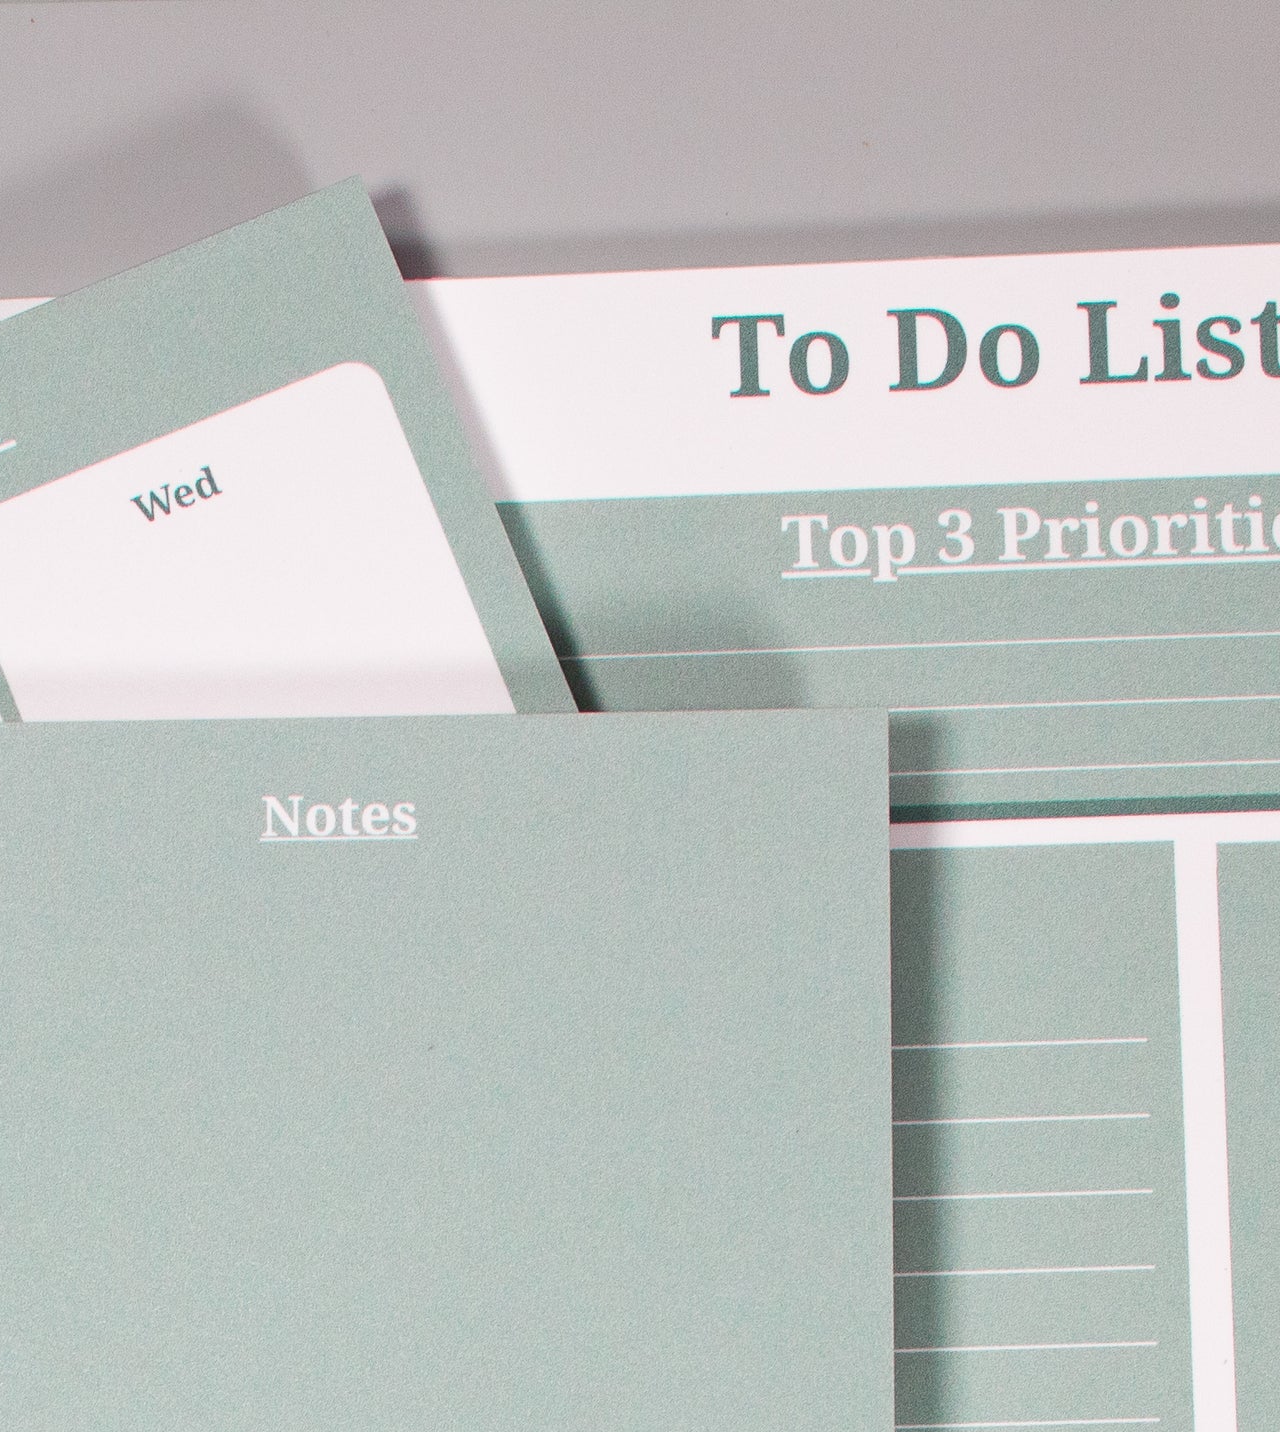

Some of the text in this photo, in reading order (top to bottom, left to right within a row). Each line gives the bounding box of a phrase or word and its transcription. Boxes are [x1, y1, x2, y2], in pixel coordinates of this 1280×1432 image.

[711, 314, 851, 397] To
[886, 307, 1041, 392] Do
[131, 466, 223, 523] Wed
[781, 513, 917, 582] Top
[938, 510, 975, 563] 3
[261, 795, 417, 837] Notes
